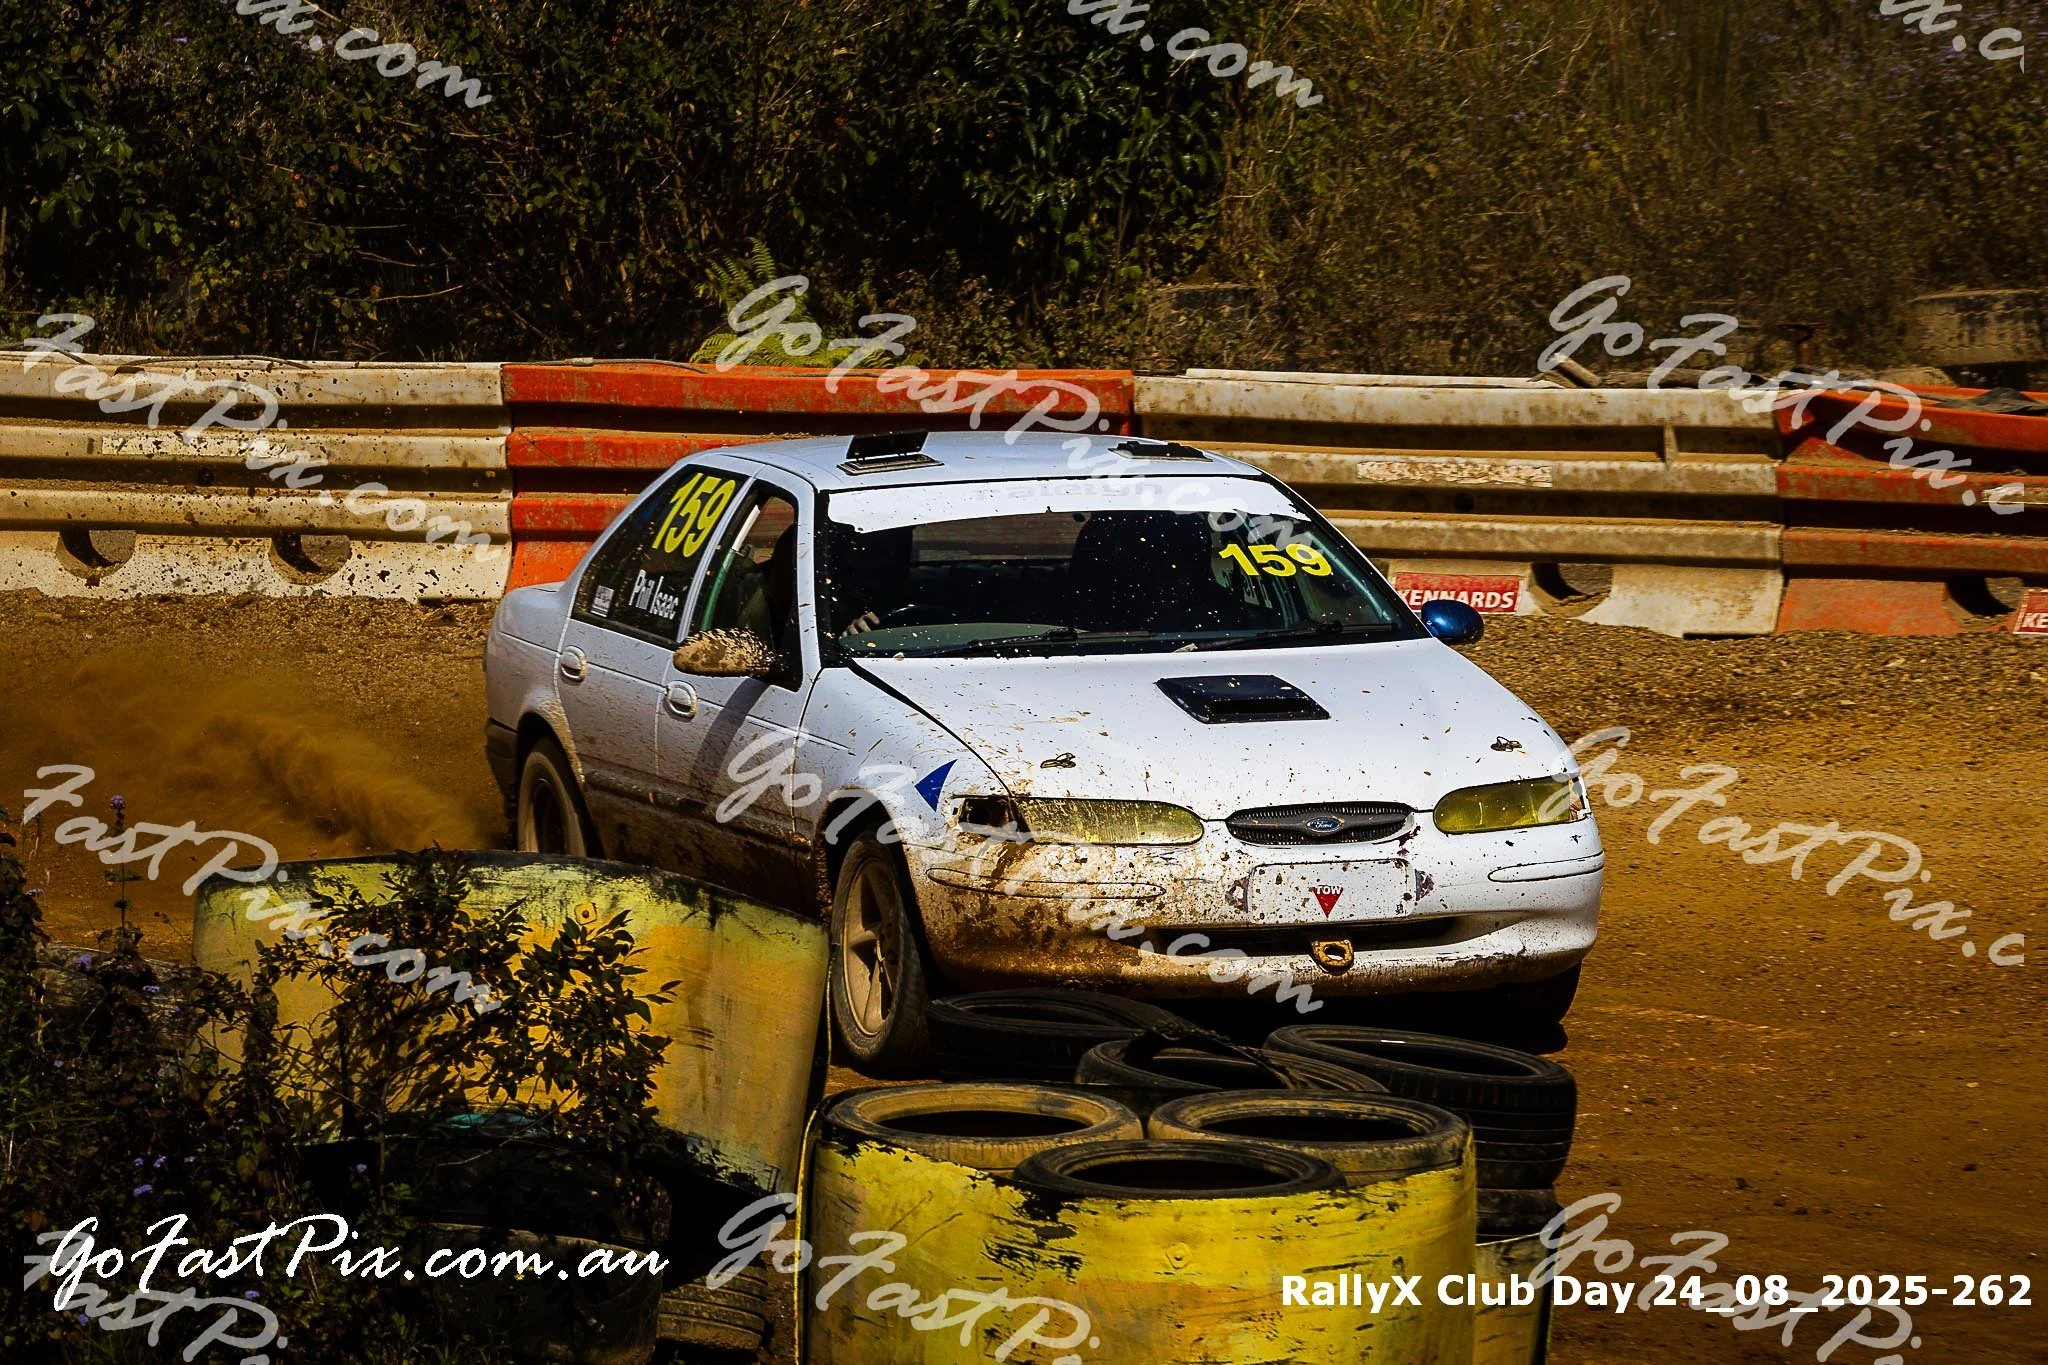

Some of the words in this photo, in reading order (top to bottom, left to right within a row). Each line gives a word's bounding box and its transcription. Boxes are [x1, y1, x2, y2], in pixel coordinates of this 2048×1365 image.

[652, 473, 735, 557] 159
[1219, 544, 1332, 577] 159
[628, 569, 655, 610] Phil
[649, 576, 679, 620] Isaac
[1316, 886, 1341, 895] TOW
